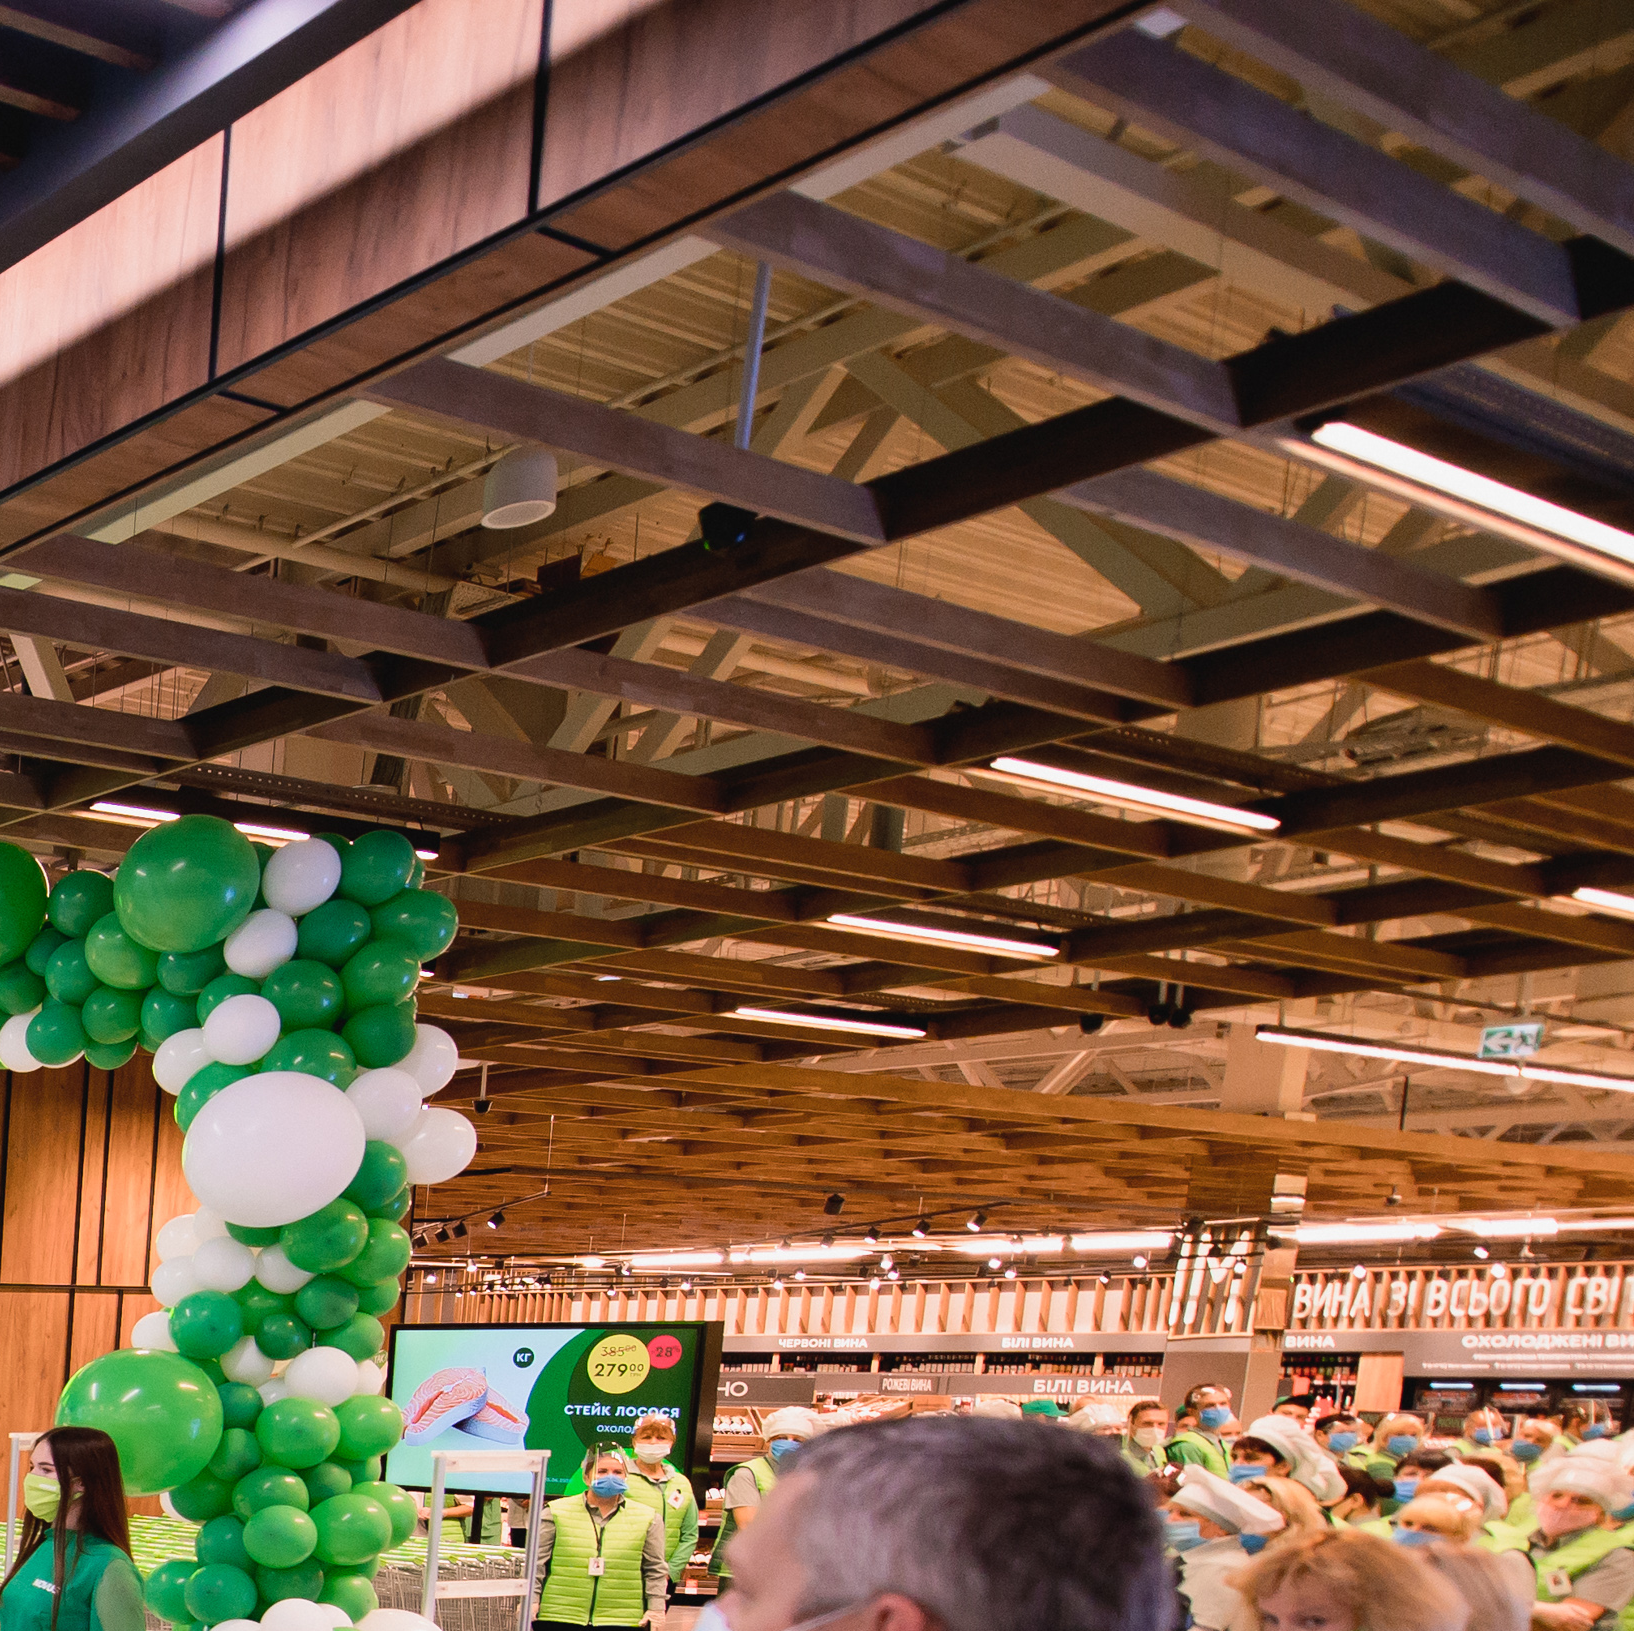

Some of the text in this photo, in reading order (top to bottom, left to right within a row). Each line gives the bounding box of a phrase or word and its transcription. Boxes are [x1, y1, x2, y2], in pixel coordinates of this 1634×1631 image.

[1293, 1281, 1372, 1320] ВИНА
[1426, 1277, 1552, 1318] ВСЬОГО
[778, 1338, 868, 1349] ЧЕРВОНІ ВИНА
[1001, 1337, 1074, 1349] БІЛІ ВИНА
[1284, 1335, 1336, 1349] ВИНА
[1461, 1334, 1604, 1350] ОХОЛОДЖЕНІ
[516, 1353, 532, 1363] КГ
[911, 1378, 932, 1391] ВИНА
[1033, 1379, 1135, 1394] БІЛІ ВИНА
[564, 1402, 681, 1419] СТЕЙК ЛОСОСЯ
